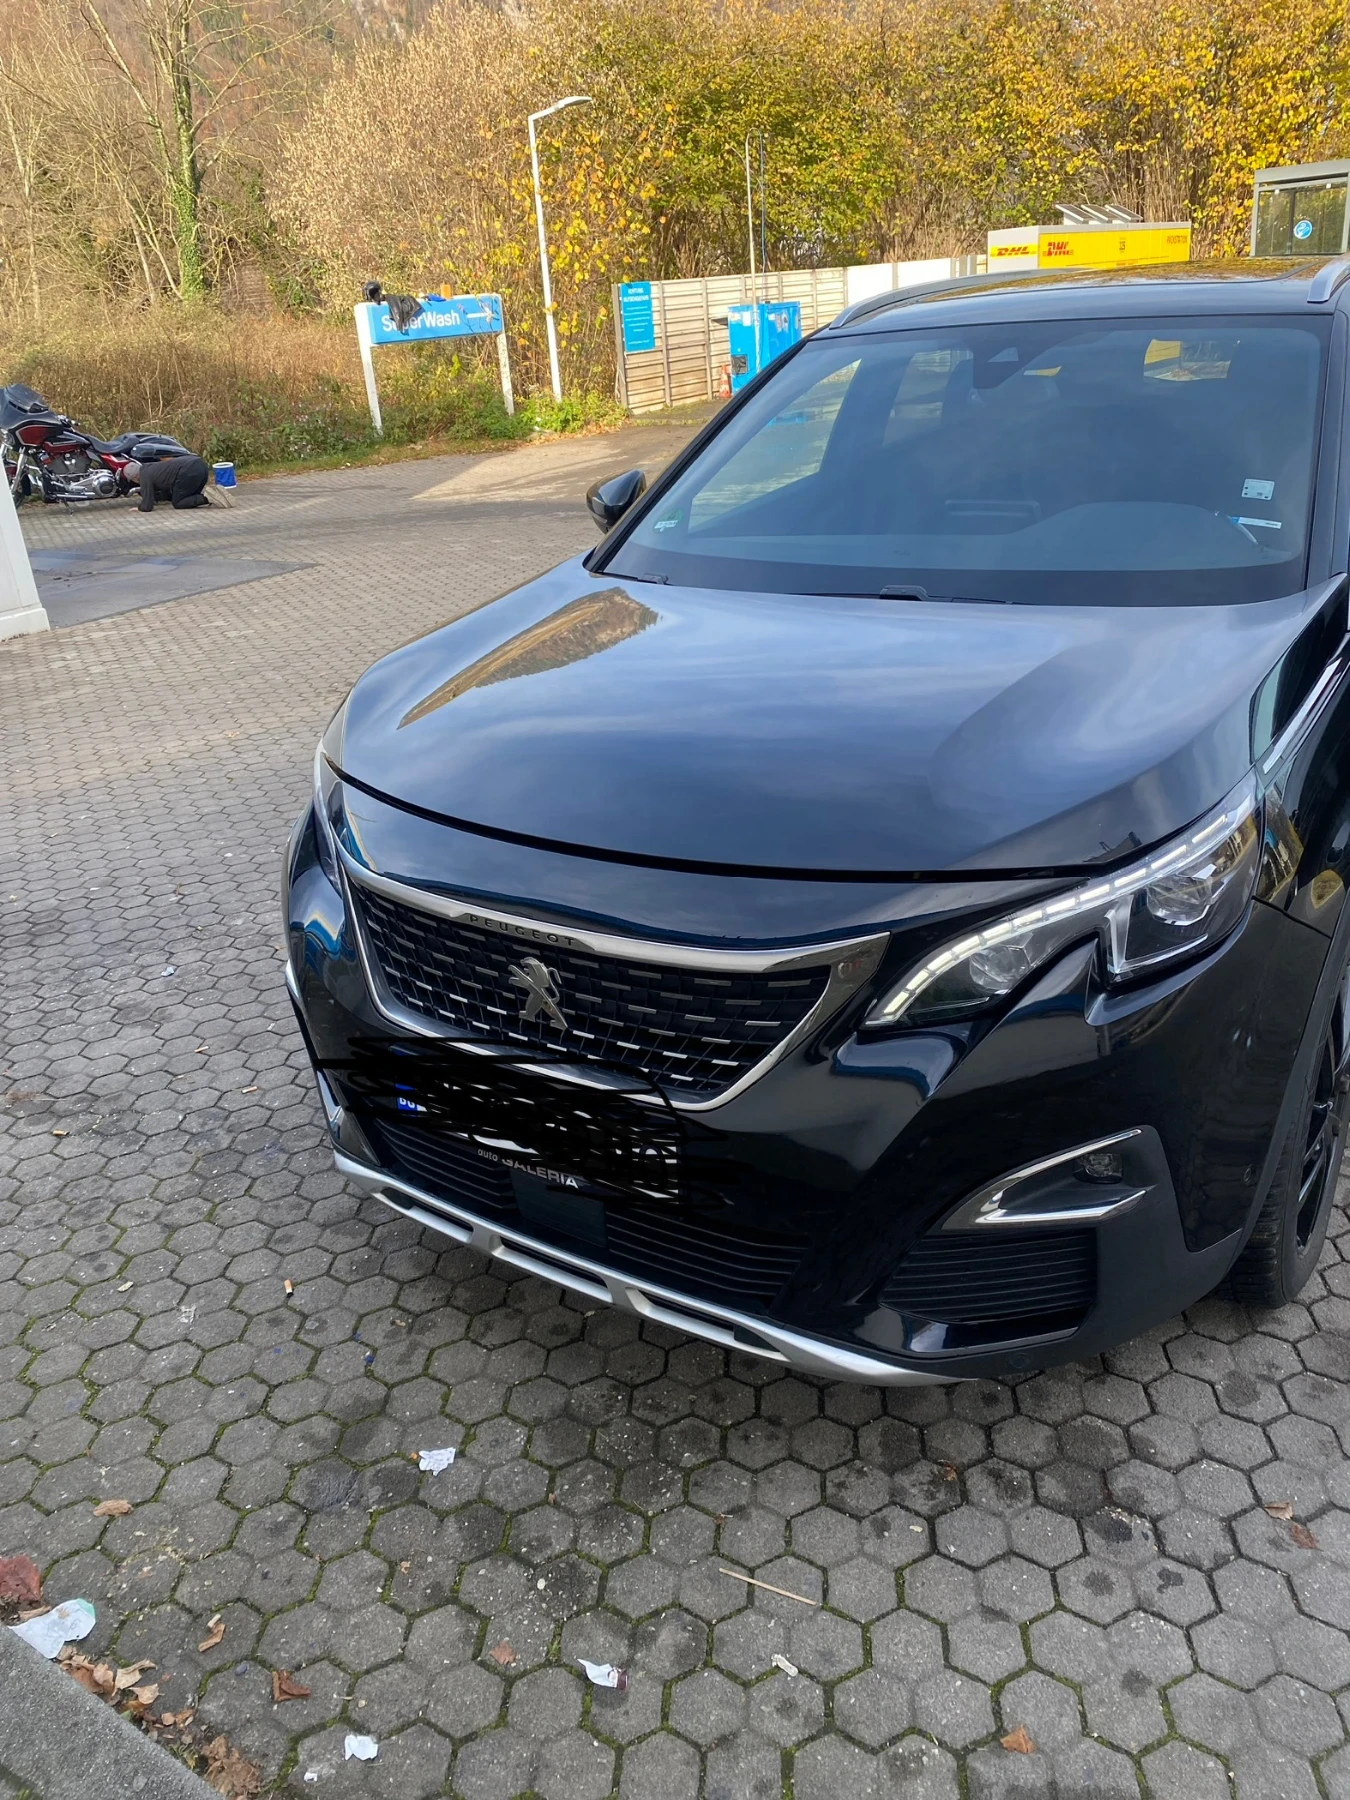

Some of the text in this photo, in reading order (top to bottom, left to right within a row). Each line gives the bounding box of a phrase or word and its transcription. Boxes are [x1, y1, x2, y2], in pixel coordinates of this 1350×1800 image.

[997, 246, 1030, 257] DHL
[469, 914, 576, 946] PEUGEOT
[477, 1148, 499, 1162] auto
